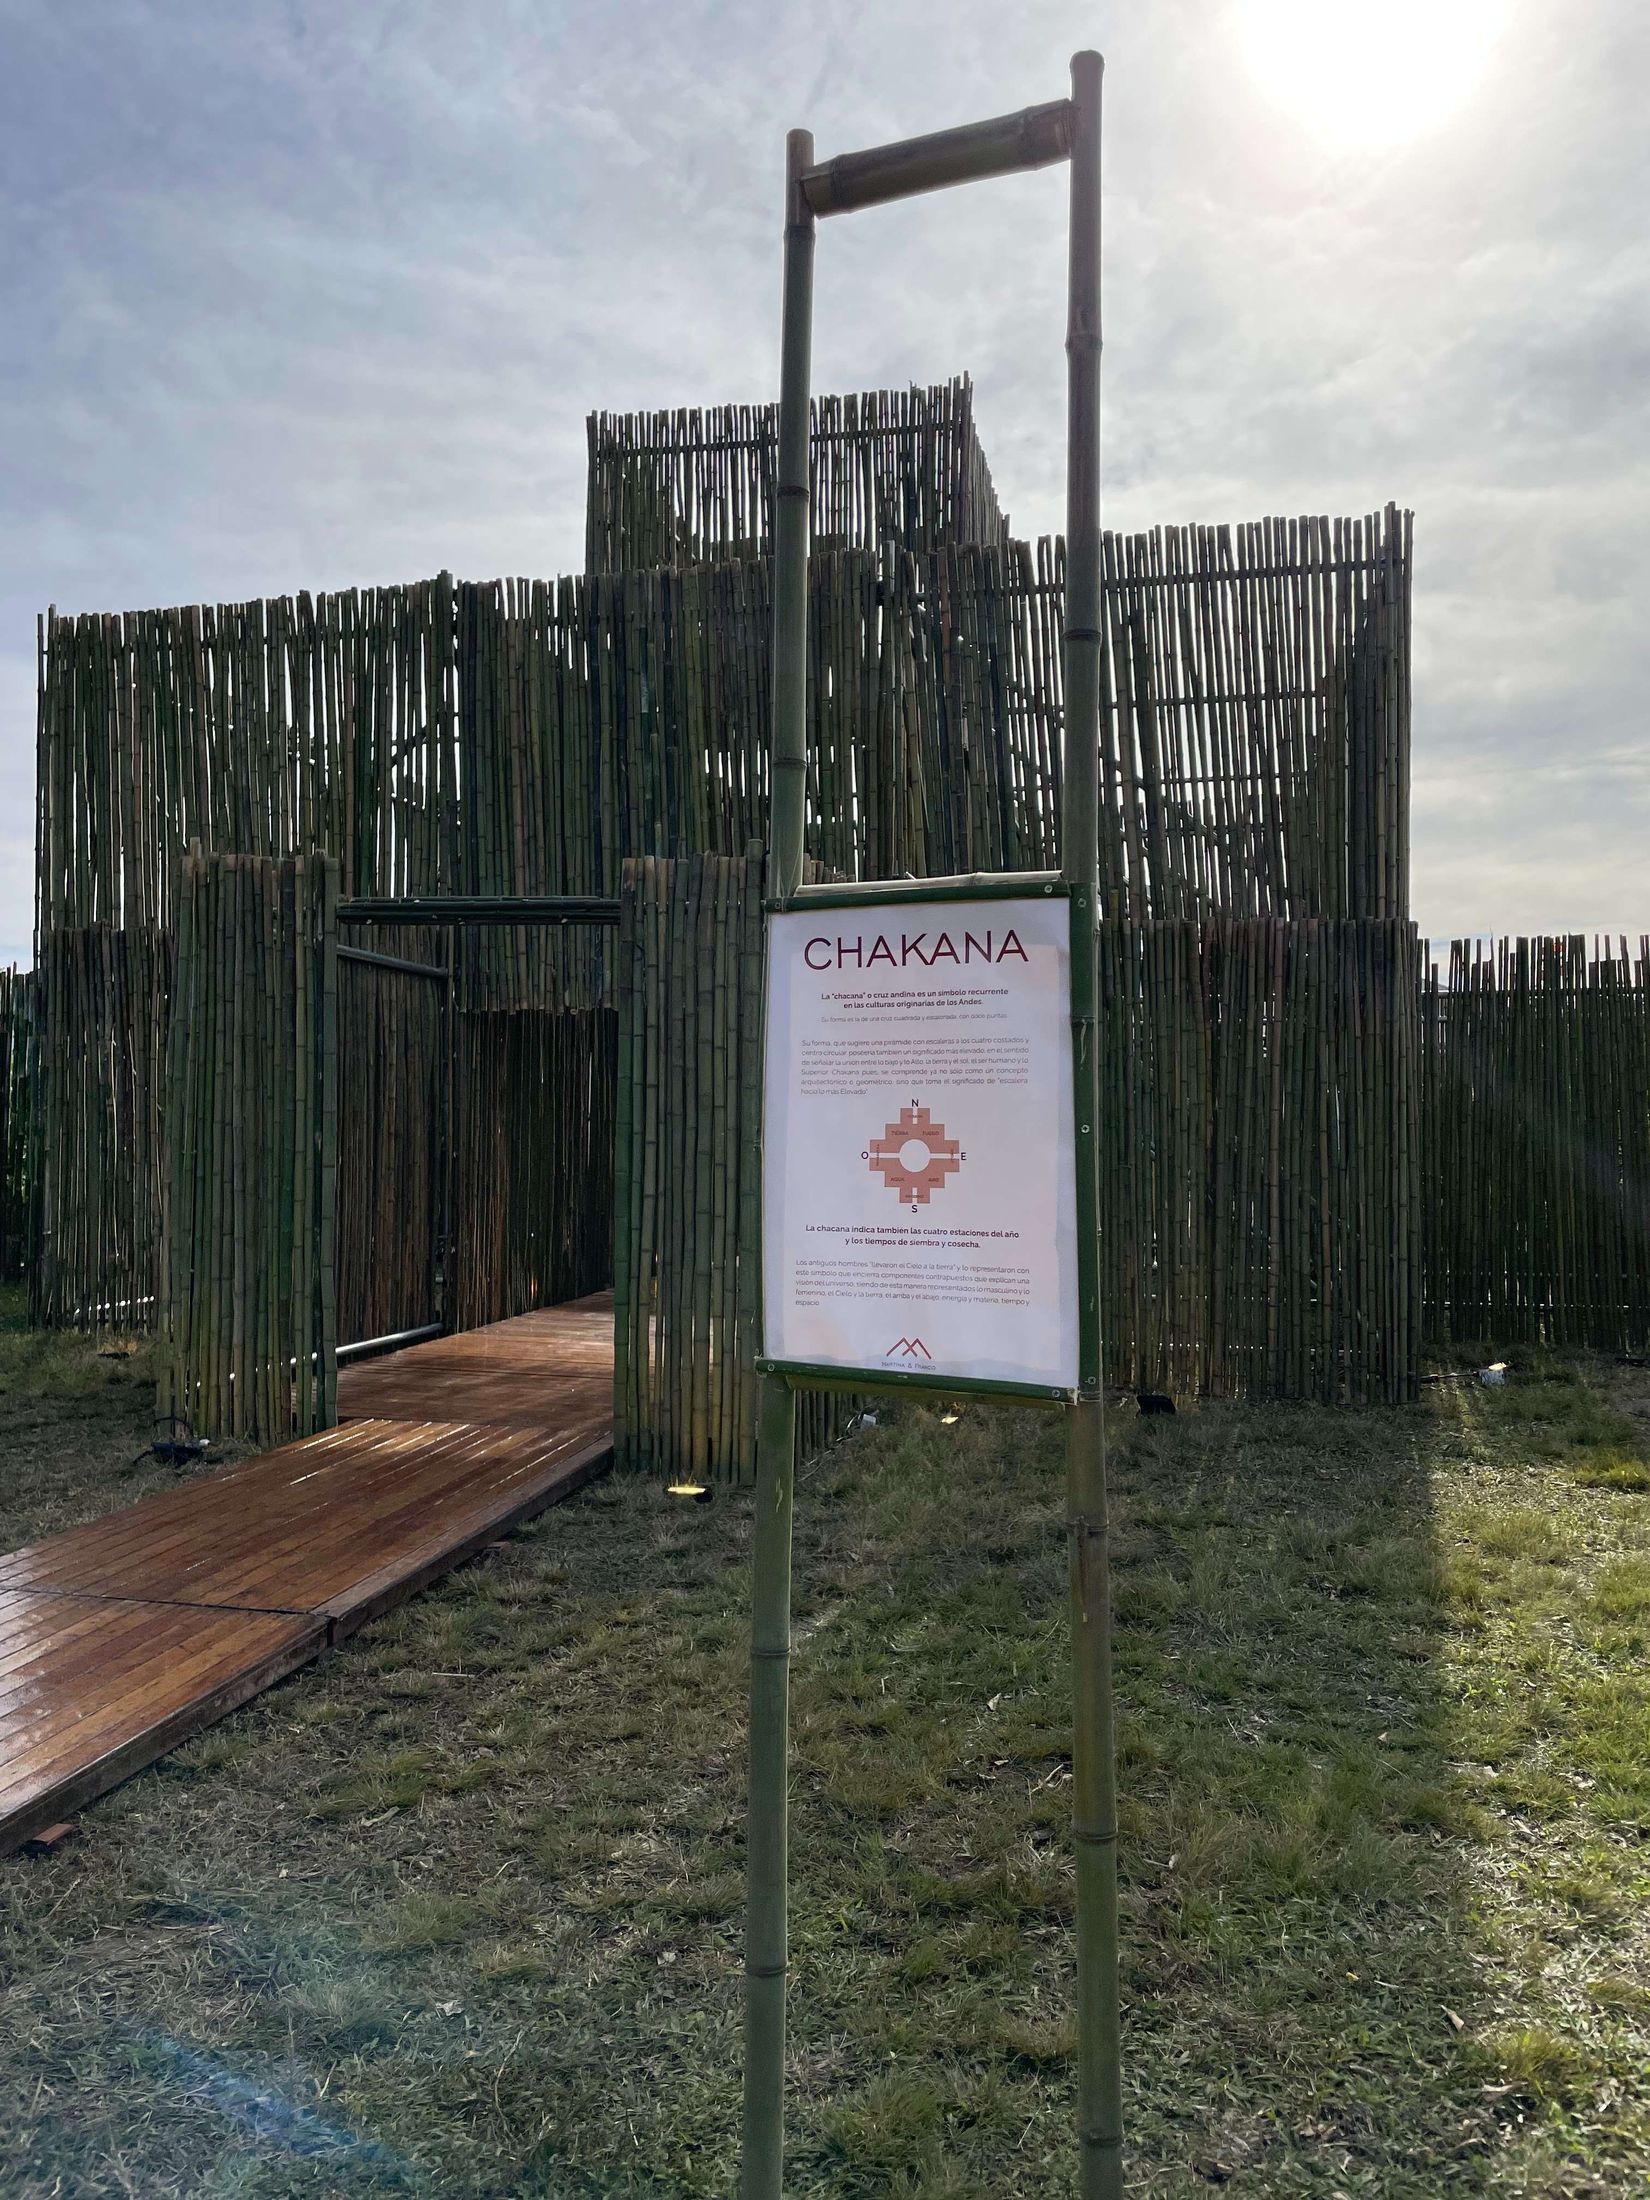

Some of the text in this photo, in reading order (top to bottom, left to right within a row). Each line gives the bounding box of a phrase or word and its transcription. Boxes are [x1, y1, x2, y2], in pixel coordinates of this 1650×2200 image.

[804, 929, 1029, 970] CHAKANA
[821, 992, 830, 1000] La
[832, 991, 866, 999] "chacana"
[890, 990, 916, 998] andina
[968, 988, 1008, 996] recurrente
[853, 1000, 864, 1008] las
[896, 999, 935, 1008] originarias
[936, 998, 946, 1006] de
[911, 1099, 919, 1108] N
[860, 1151, 869, 1160] O
[960, 1152, 968, 1161] E
[911, 1204, 918, 1213] S
[805, 1224, 816, 1232] La
[816, 1225, 850, 1233] chacana
[851, 1226, 876, 1234] indica
[911, 1227, 922, 1235] las
[923, 1228, 948, 1236] cuatro
[950, 1229, 990, 1237] estaciones
[991, 1230, 1004, 1238] del
[1005, 1230, 1020, 1238] año
[845, 1238, 851, 1246] y
[865, 1237, 896, 1247] tiempos
[897, 1238, 908, 1246] de
[910, 1239, 940, 1247] siembra
[941, 1241, 946, 1249] y
[947, 1240, 980, 1248] cosecha.
